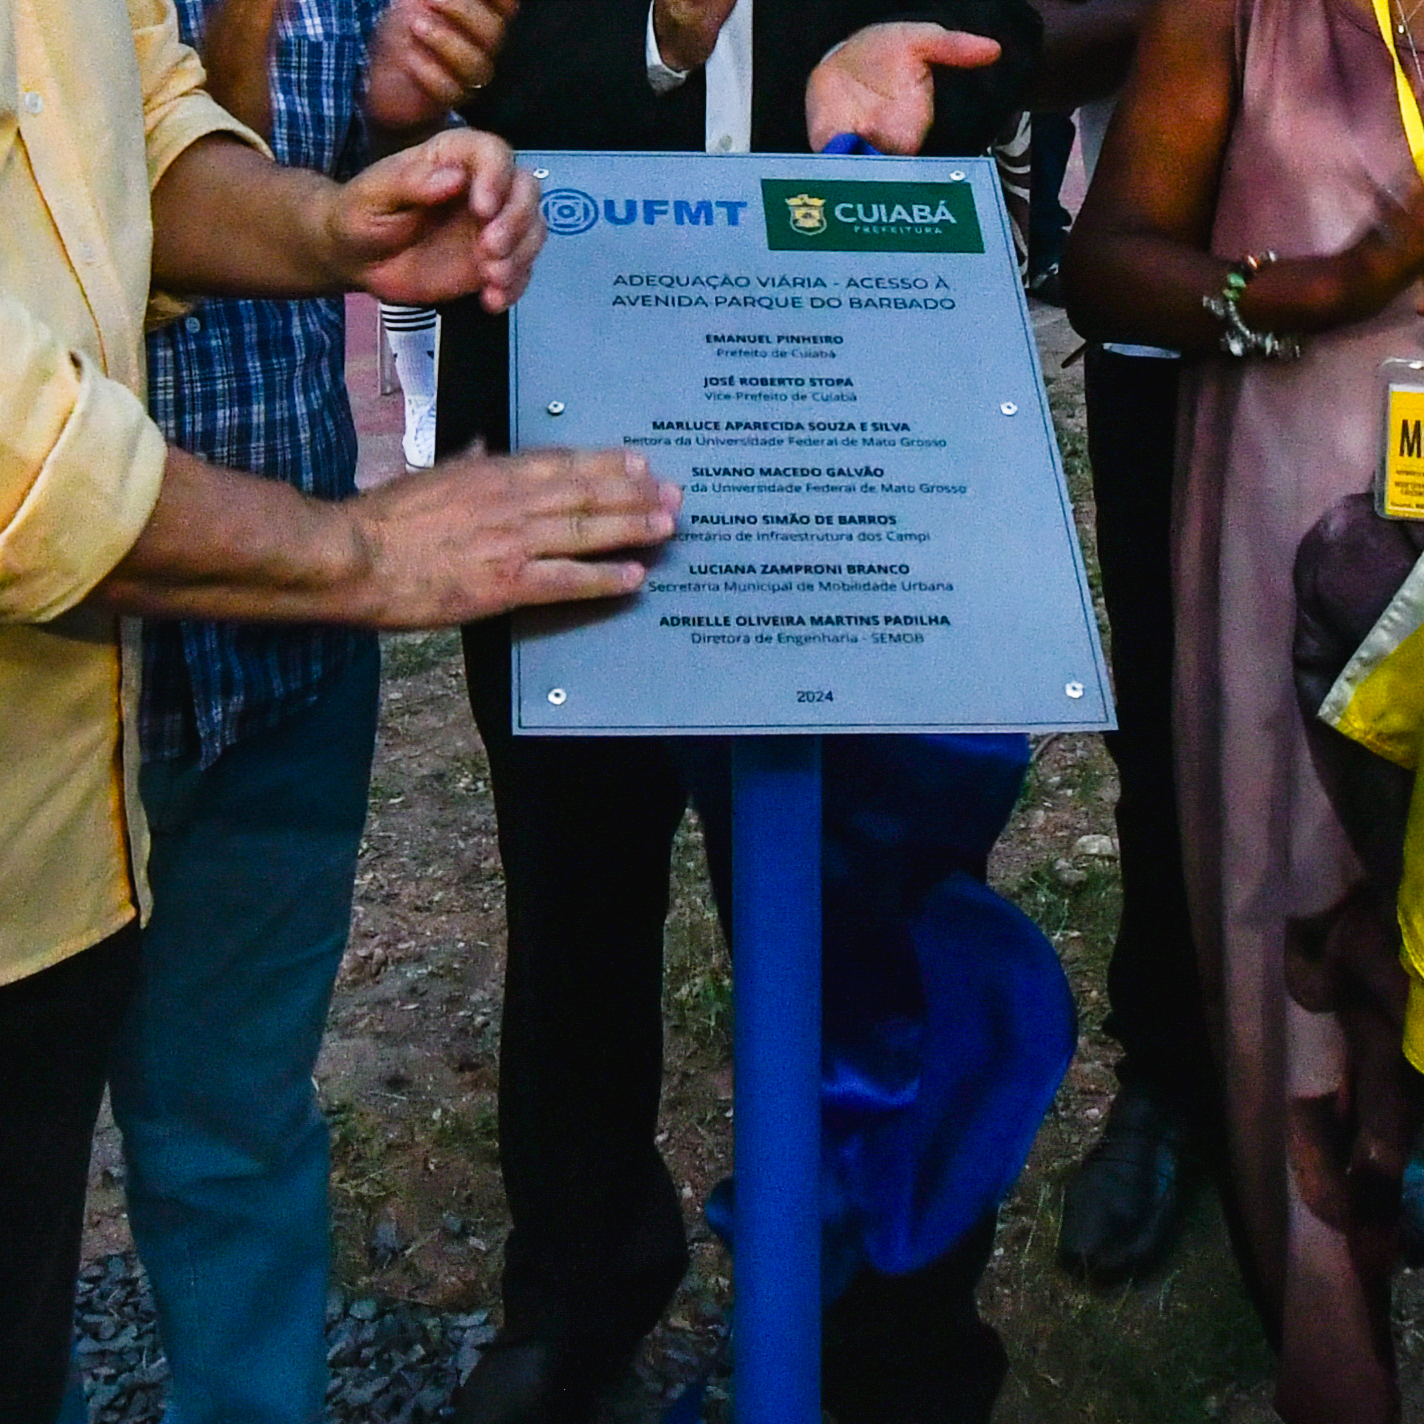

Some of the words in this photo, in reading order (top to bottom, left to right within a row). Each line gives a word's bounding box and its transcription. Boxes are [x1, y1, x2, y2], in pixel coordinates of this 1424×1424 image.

[603, 198, 748, 226] UFMT
[834, 200, 957, 225] CUIABÁ
[853, 226, 943, 235] PREFEITURA
[613, 273, 750, 290] ADEQUAÇÃO
[756, 274, 828, 289] VIÁRIA
[846, 276, 928, 290] ACESSO
[612, 295, 708, 308] AVENIDA
[715, 296, 803, 310] PARQUE
[810, 297, 842, 309] DO
[849, 297, 956, 310] BARBADO
[705, 334, 772, 344] EMANUEL
[777, 335, 844, 345] PINHEIRO
[716, 348, 768, 358] Prefeito
[771, 349, 788, 358] de
[791, 349, 837, 359] Cuiabá
[703, 376, 735, 388] JOSÉ
[740, 377, 805, 387] ROBERTO
[809, 378, 854, 387] STOPA
[704, 392, 788, 402] Vice-Prefeito
[791, 392, 807, 401] de
[652, 421, 721, 431] MARLUCE
[725, 421, 805, 431] APARECIDA
[808, 422, 857, 432] SOUZA
[860, 422, 868, 432] E
[871, 422, 911, 432] SILVA
[675, 436, 692, 446] da
[695, 436, 785, 447] Universidade
[789, 437, 838, 447] Federal
[841, 437, 858, 447] de
[862, 437, 897, 447] Mato
[900, 437, 947, 447] Grosso
[692, 467, 755, 477] SILVANO
[759, 467, 822, 477] MACEDO
[826, 465, 885, 477] GALVÃO
[691, 483, 708, 493] da
[712, 483, 802, 493] Universidade
[806, 483, 856, 493] Federal
[860, 483, 876, 493] de
[880, 483, 916, 493] Mato
[919, 483, 967, 493] Grosso
[691, 515, 758, 525] PAULINO
[762, 513, 810, 525] SIMÃO
[815, 515, 833, 525] DE
[838, 515, 897, 525] BARROS
[677, 531, 732, 542] cretário
[735, 531, 753, 541] de
[757, 531, 853, 542] Infraestrutura
[857, 531, 882, 541] dos
[886, 531, 930, 543] Campi
[689, 564, 756, 575] LUCIANA
[760, 564, 842, 575] ZAMPRONI
[847, 564, 910, 575] BRANCO
[724, 581, 793, 594] Municipal
[796, 581, 814, 591] de
[818, 581, 898, 592] Mobilidade
[901, 581, 954, 592] Urbana
[659, 616, 732, 626] ADRIELLE
[735, 615, 806, 626] OLIVEIRA
[810, 615, 880, 626] MARTINS
[884, 615, 951, 626] PADILHA
[691, 633, 750, 644] Diretora
[755, 633, 773, 644] de
[777, 633, 859, 646] Engenharia
[871, 633, 925, 644] SEMOB
[796, 690, 834, 703] 2024
